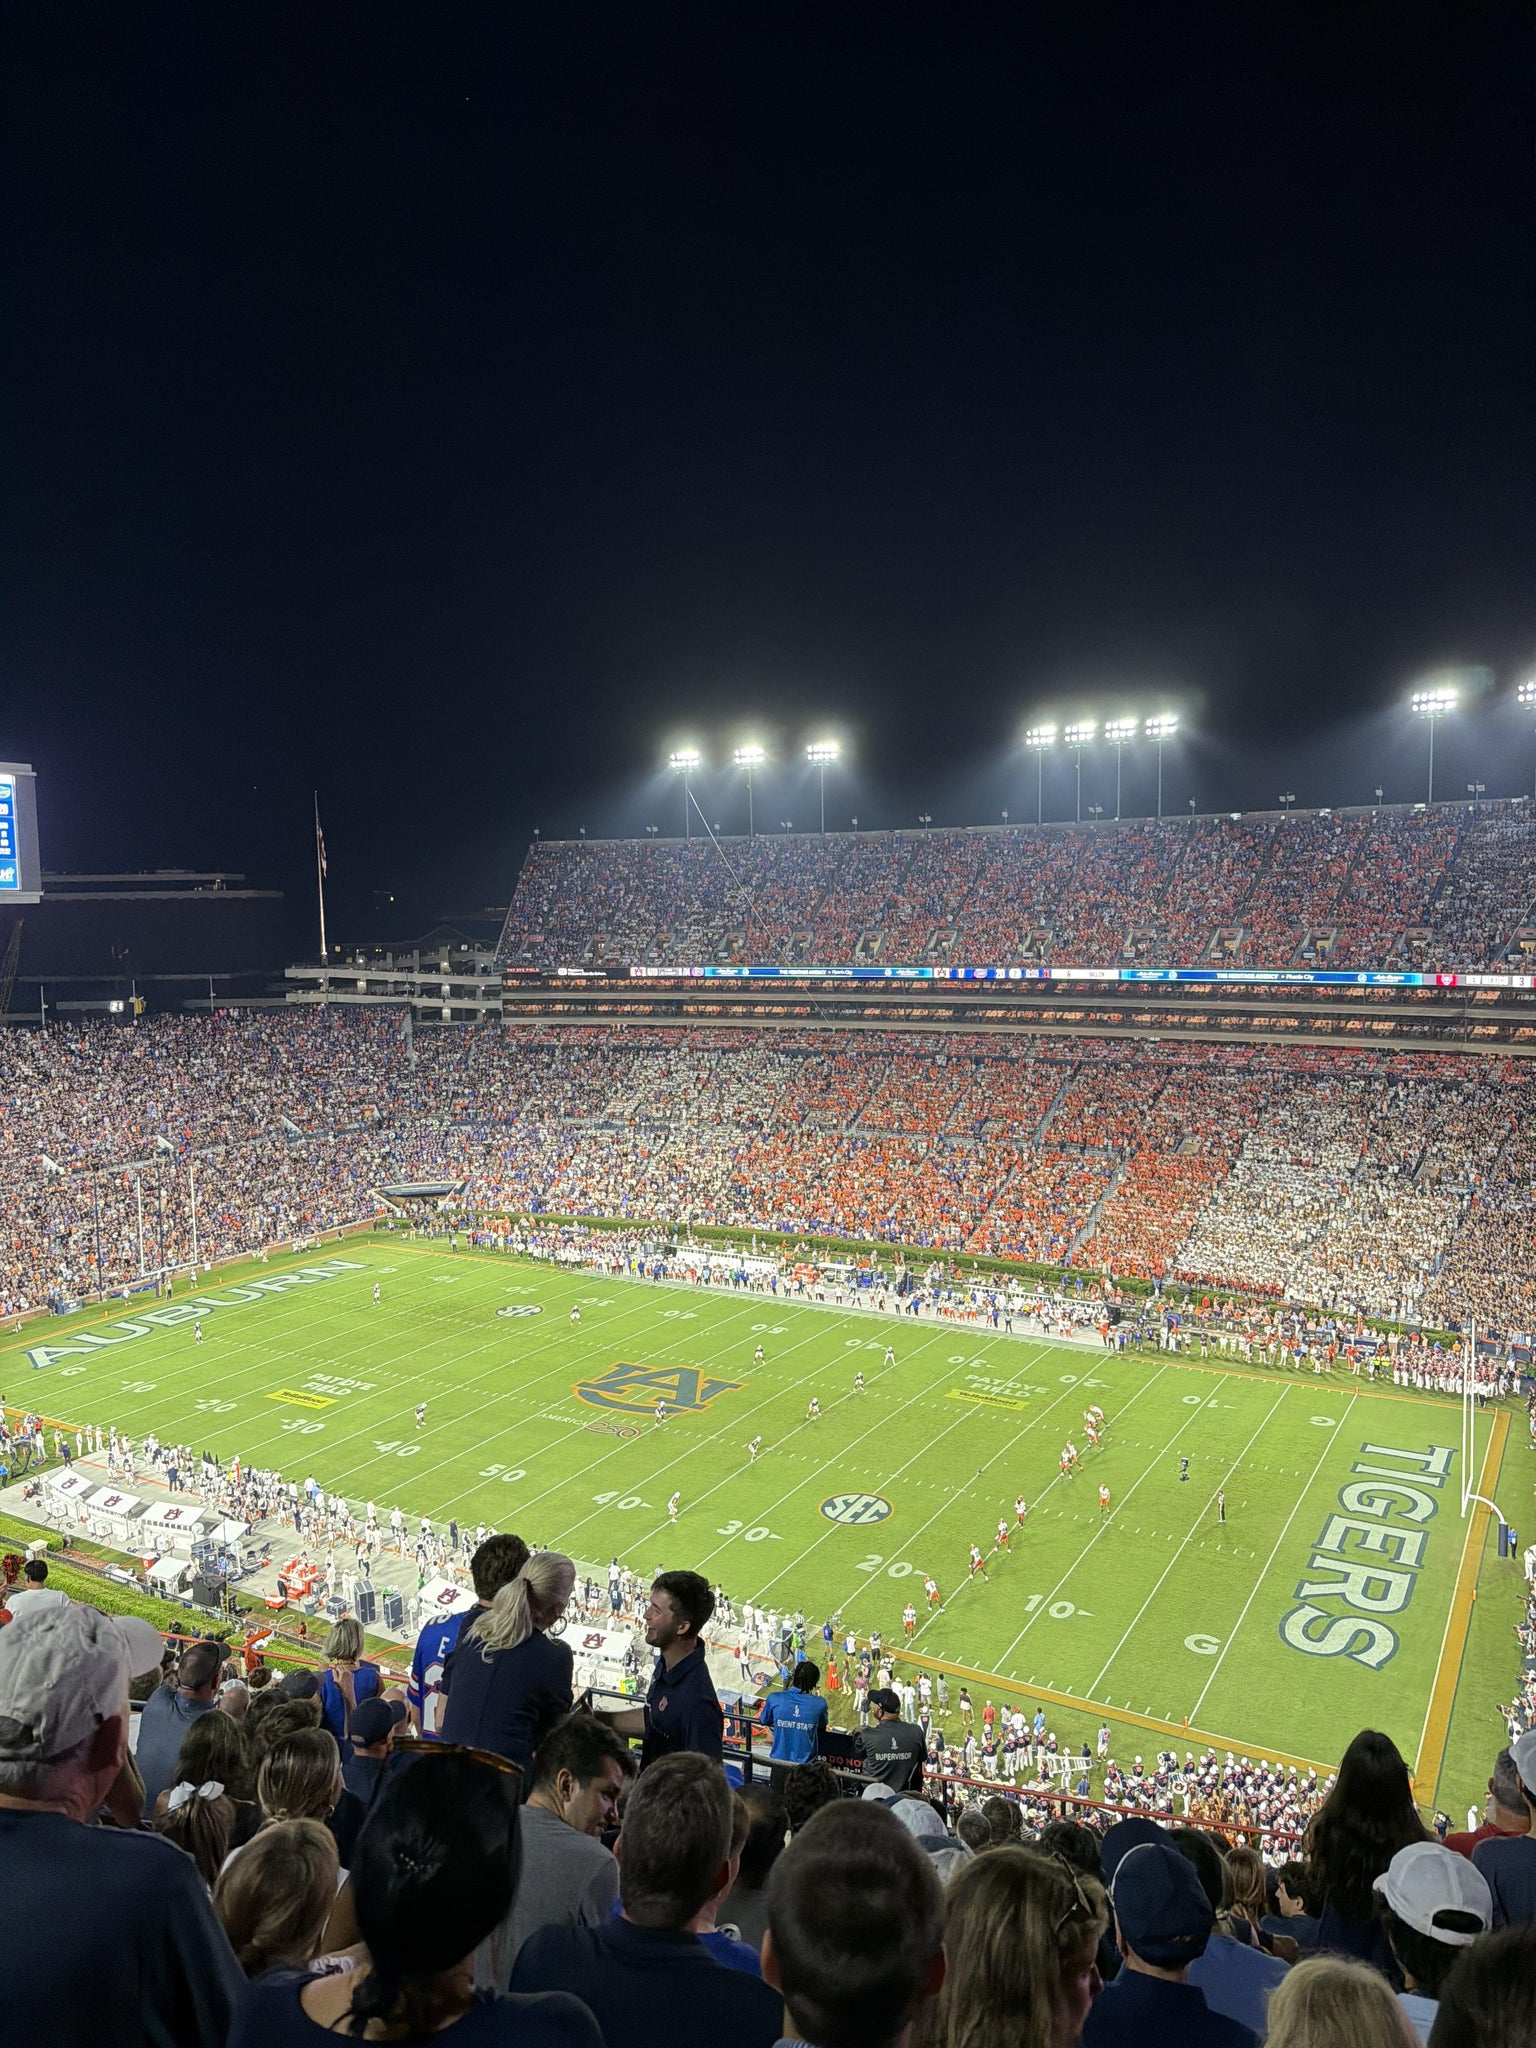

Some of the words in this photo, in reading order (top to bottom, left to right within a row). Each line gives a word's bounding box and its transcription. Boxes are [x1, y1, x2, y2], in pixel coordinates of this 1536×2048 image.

[22, 1259, 374, 1369] AUBURN
[308, 1373, 344, 1383] PAT
[964, 1374, 1005, 1385] PAT
[1006, 1381, 1050, 1393] DYE
[301, 1382, 352, 1396] FIELD
[970, 1382, 1031, 1397] FIELD
[194, 1399, 238, 1413] 20
[281, 1418, 326, 1434] 30
[537, 1413, 588, 1427] AMERICA
[375, 1440, 422, 1457] 40
[478, 1463, 527, 1482] 50
[592, 1490, 642, 1510] 40
[824, 1494, 890, 1524] SEC
[716, 1520, 770, 1542] 30
[1278, 1442, 1458, 1671] TIGERS
[855, 1554, 913, 1578] 20
[1024, 1593, 1076, 1619] 10
[1184, 1633, 1222, 1655] G
[777, 1719, 796, 1729] EVENT
[846, 1758, 864, 1768] NO
[875, 1752, 912, 1761] SUPERVISOR
